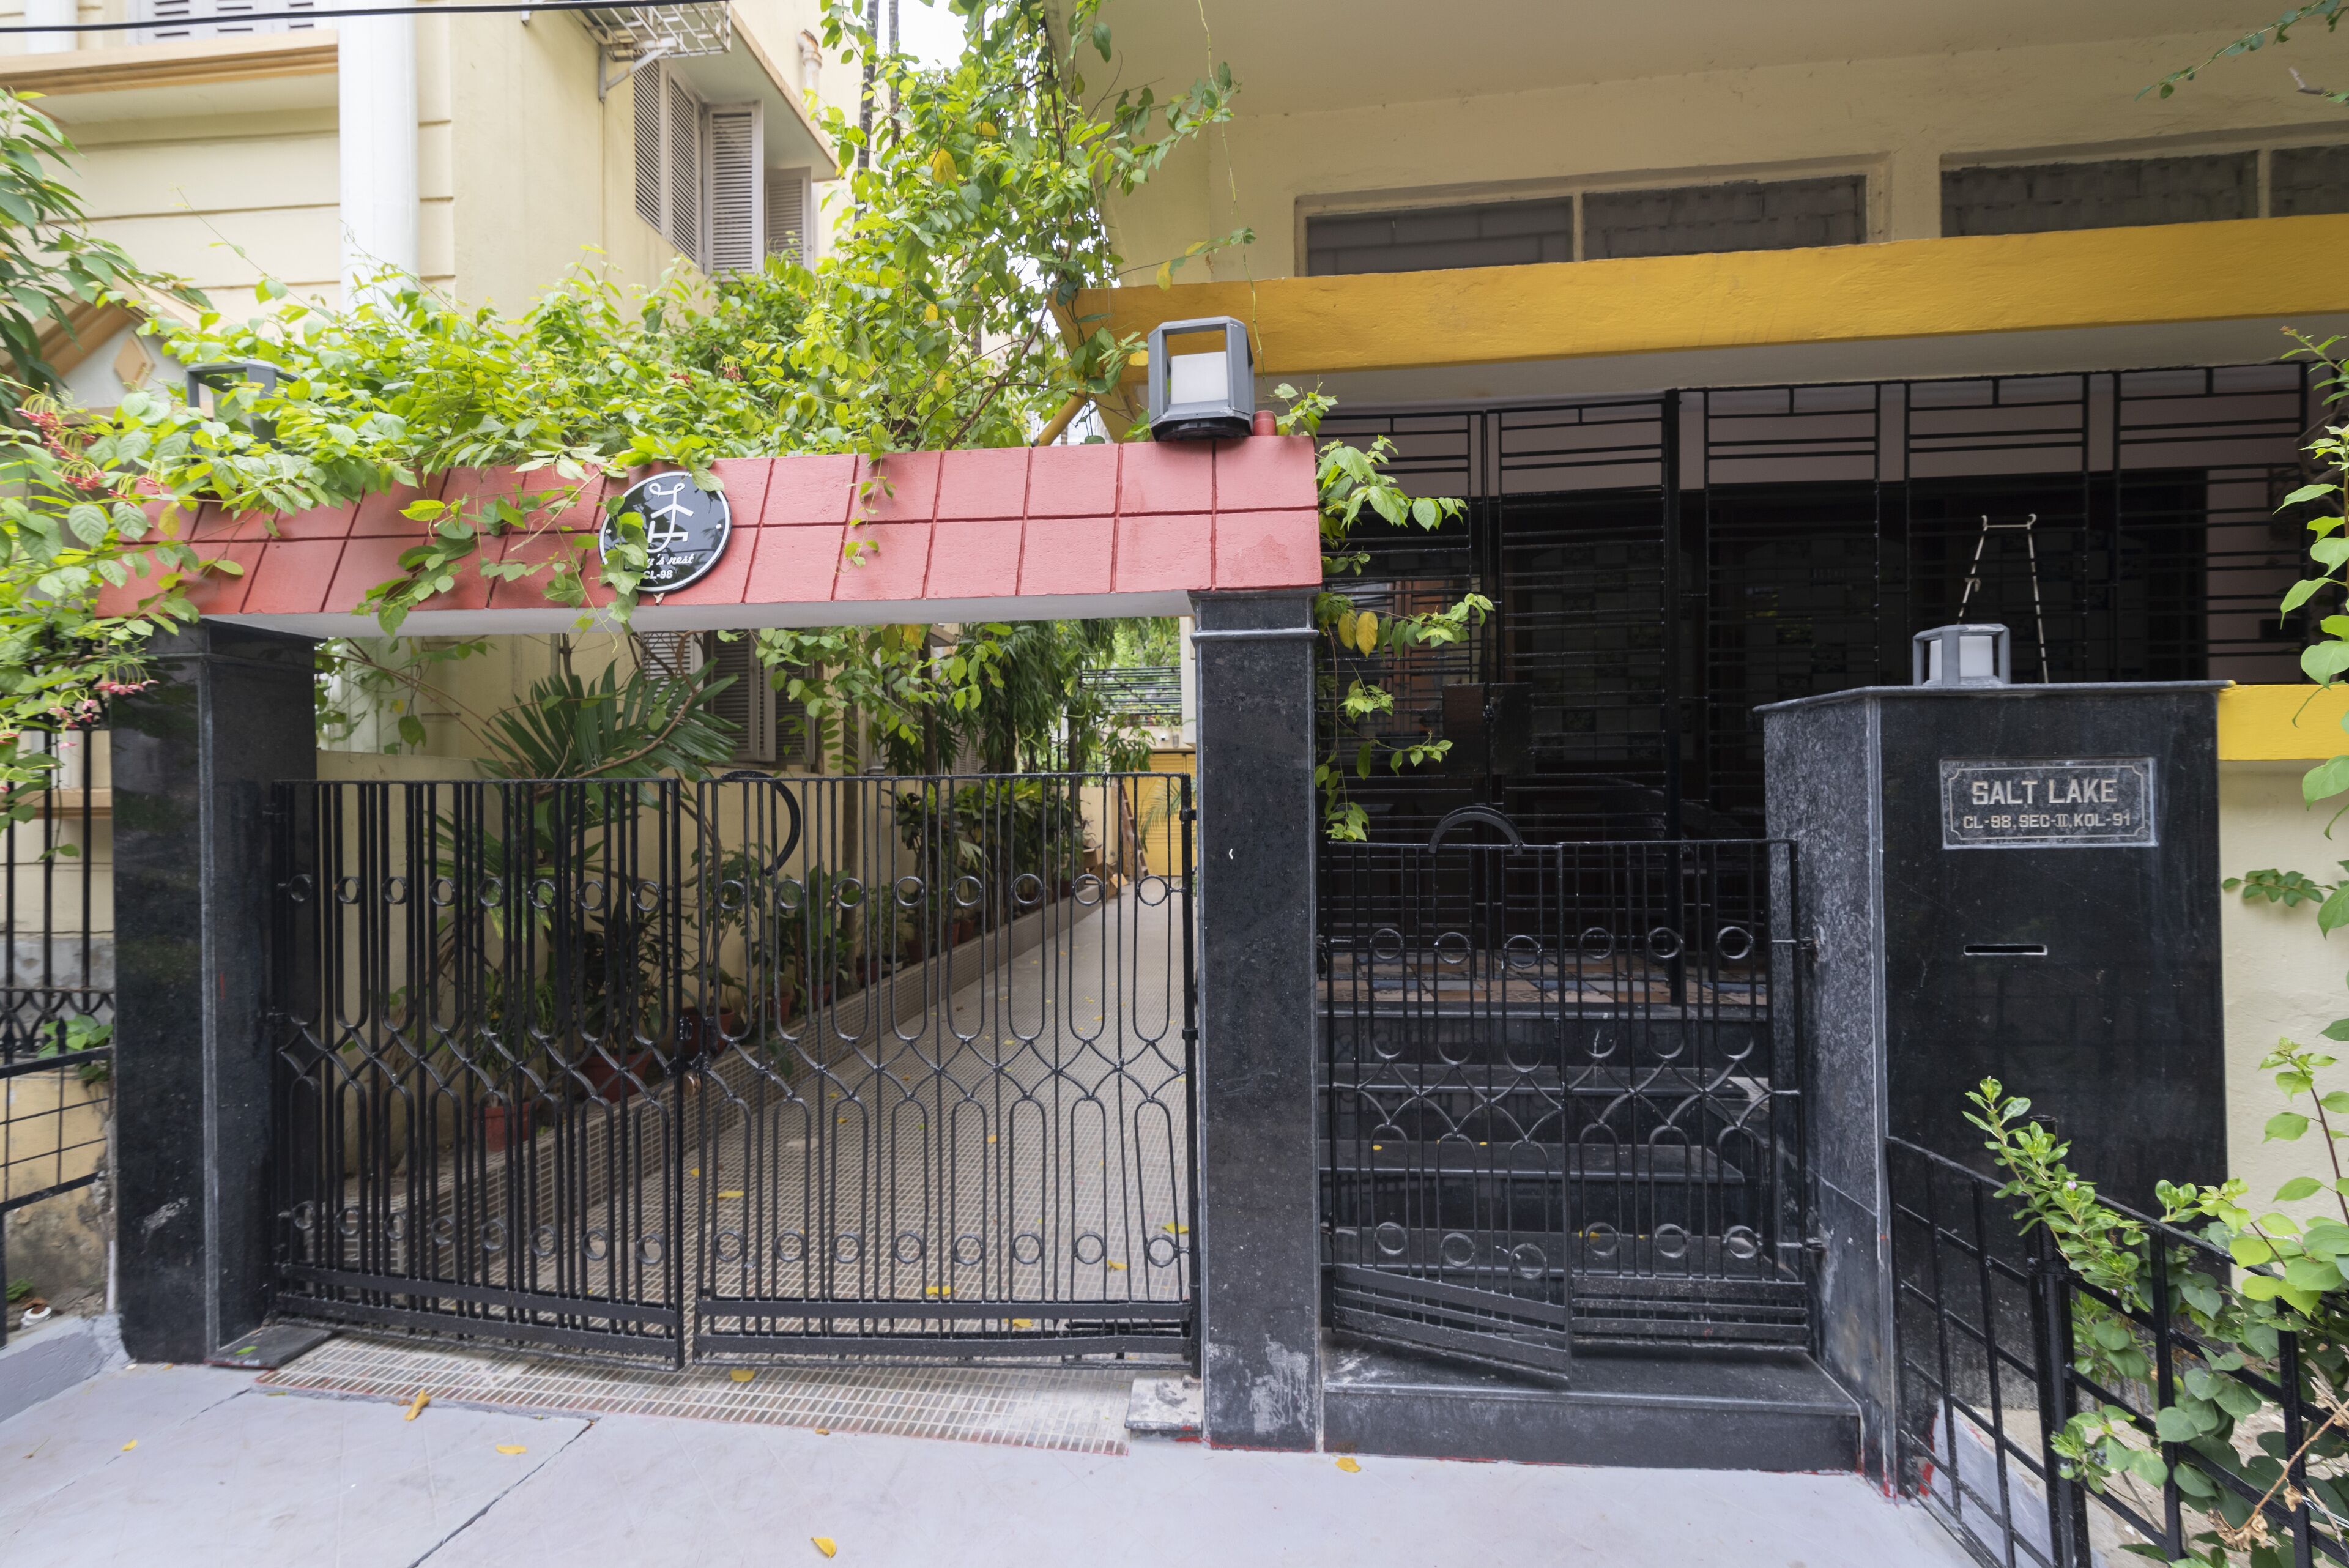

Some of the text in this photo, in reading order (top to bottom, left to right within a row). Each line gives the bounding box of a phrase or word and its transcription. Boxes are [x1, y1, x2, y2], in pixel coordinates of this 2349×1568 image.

[667, 553, 694, 565] nest
[644, 570, 674, 579] CL-98
[1972, 778, 2118, 805] SALT LAKE
[2073, 812, 2131, 827] KOL-91
